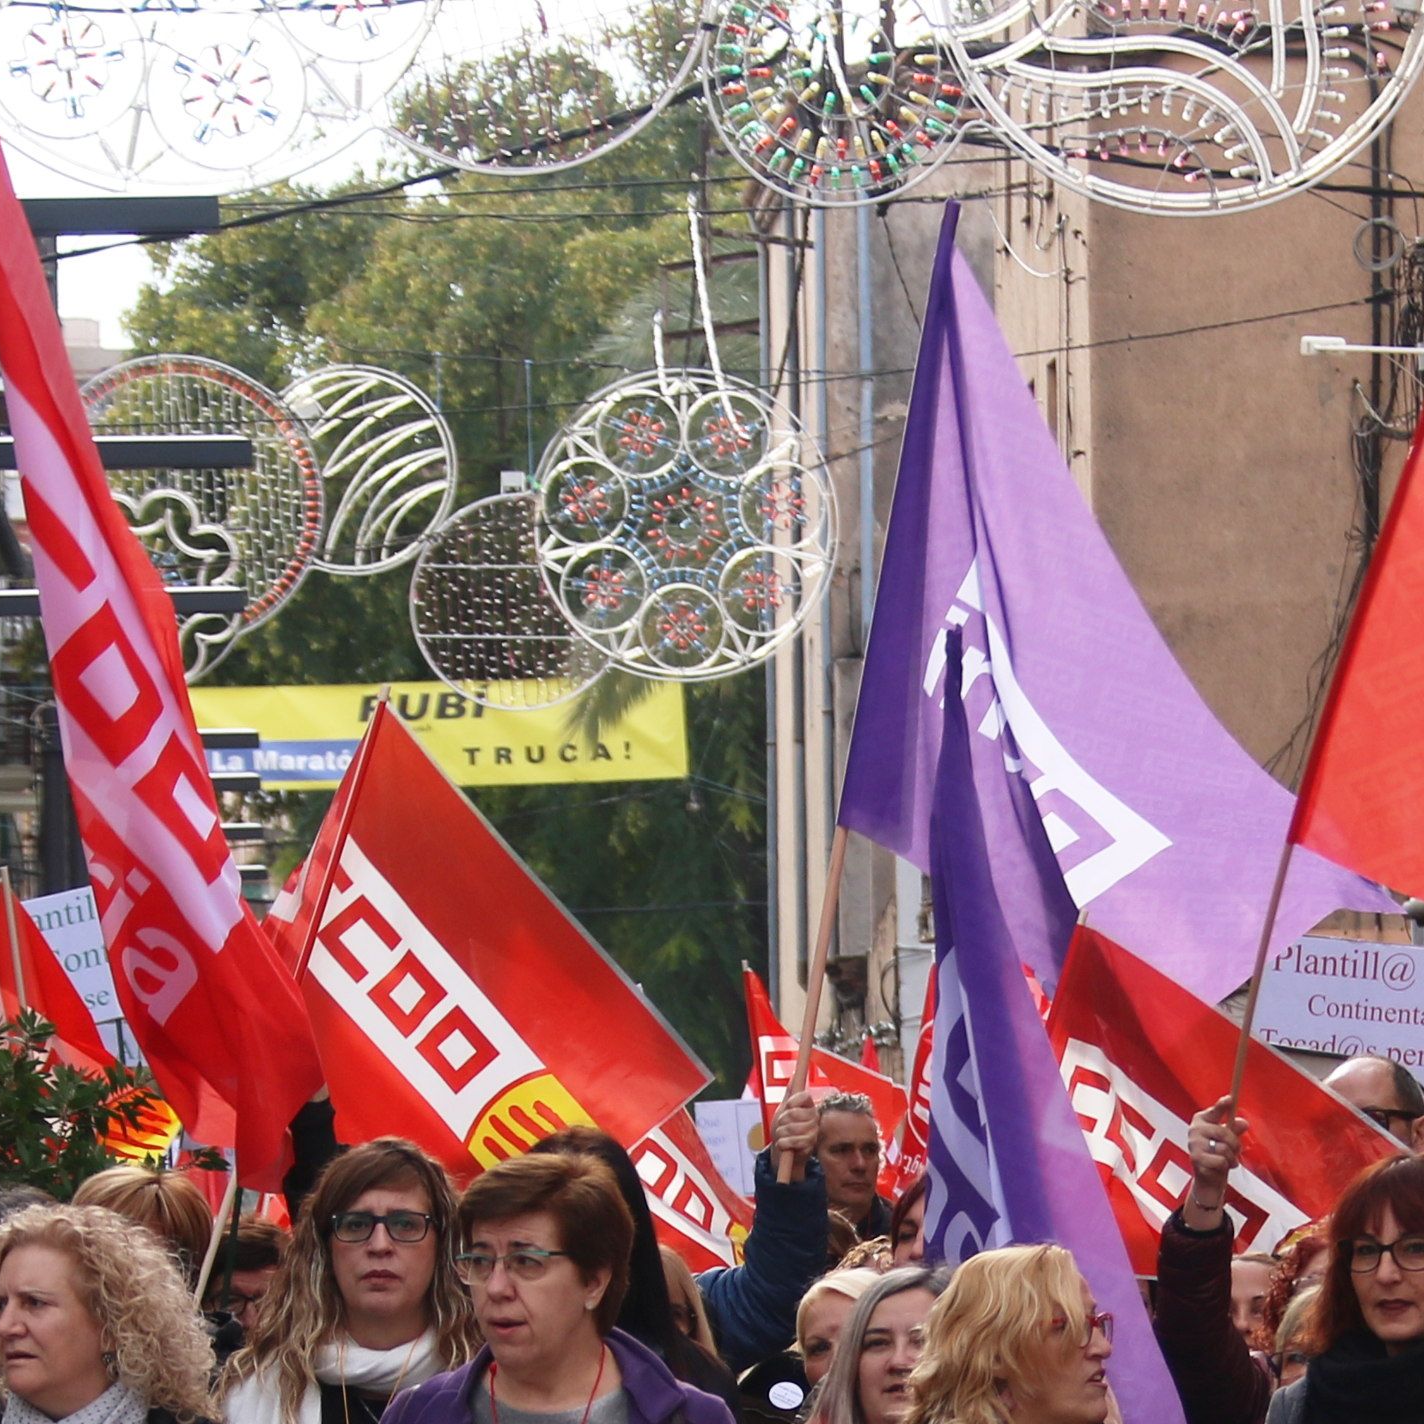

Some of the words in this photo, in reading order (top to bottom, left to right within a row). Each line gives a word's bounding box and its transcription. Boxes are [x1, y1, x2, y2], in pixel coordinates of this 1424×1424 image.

[212, 750, 244, 773] La
[252, 748, 352, 773] Marató
[463, 741, 633, 765] TRUCA!
[317, 862, 500, 1095] COO
[1273, 944, 1417, 992] Plantill@
